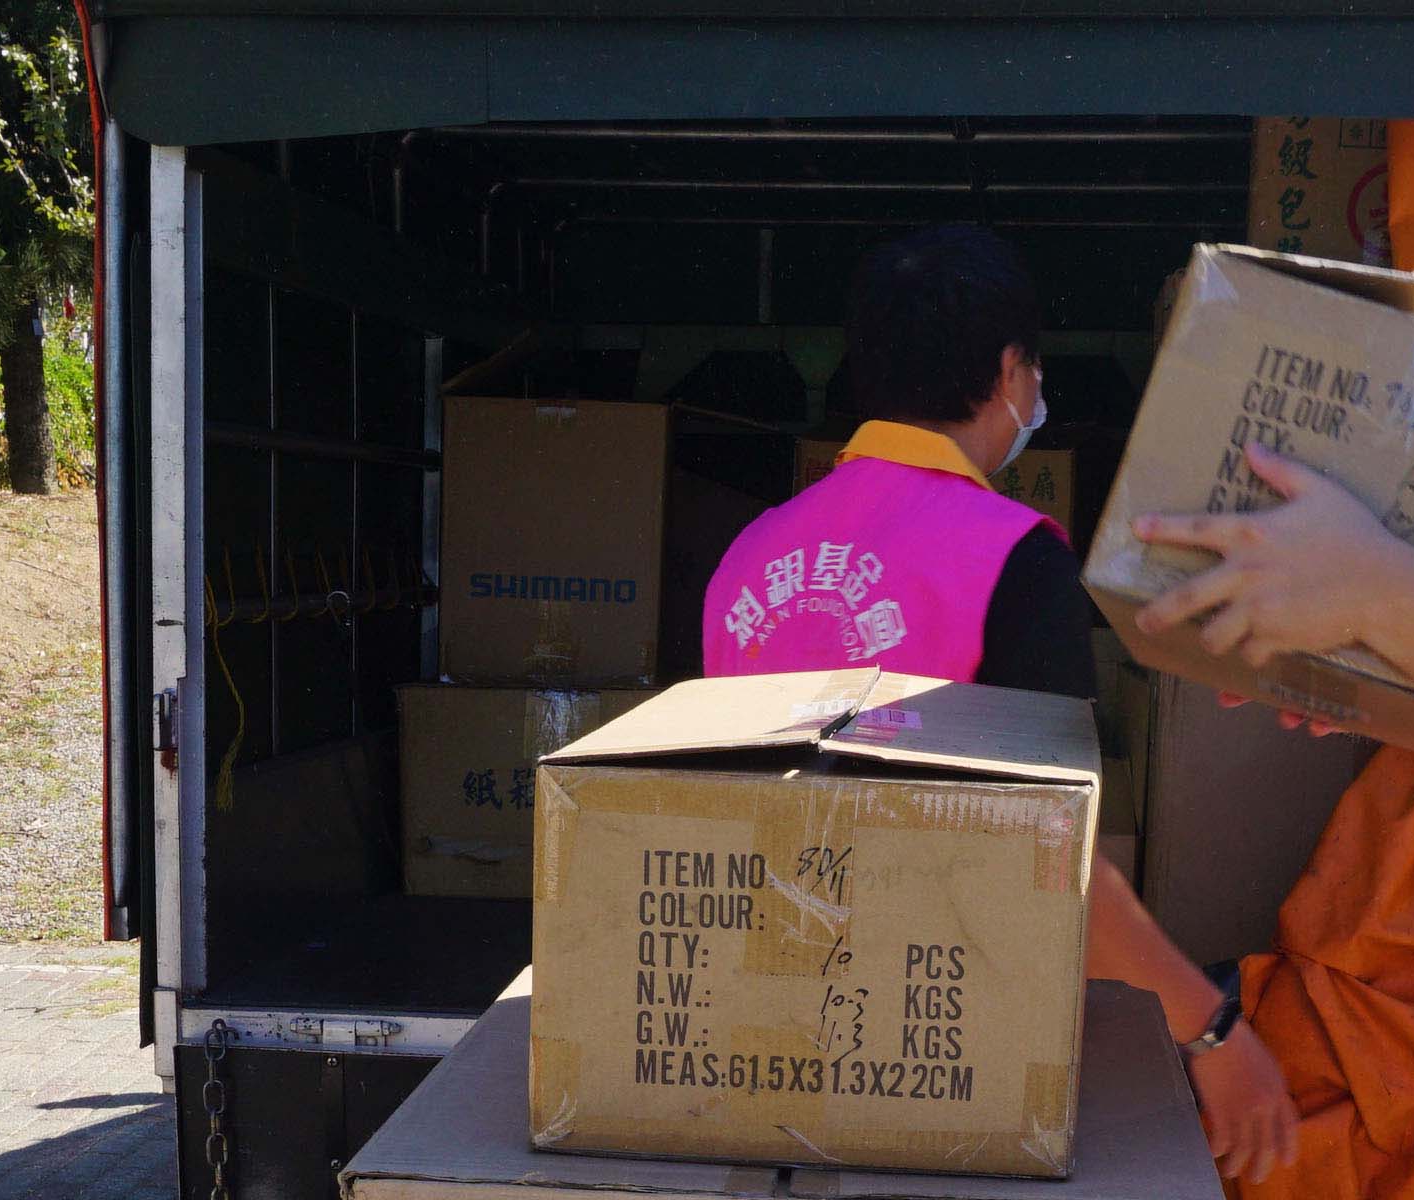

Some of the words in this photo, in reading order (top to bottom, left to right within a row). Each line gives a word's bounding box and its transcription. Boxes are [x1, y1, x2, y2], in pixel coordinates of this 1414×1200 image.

[1255, 347, 1325, 393] ITEM
[1243, 380, 1356, 444] COLOUR:
[469, 573, 637, 604] SHIMANO
[643, 850, 715, 888] ITEM
[639, 891, 765, 931] COLOUR:
[638, 930, 709, 968] QTY:
[905, 943, 966, 981] PCS
[904, 984, 963, 1021] KGS
[902, 1024, 963, 1061] KGS
